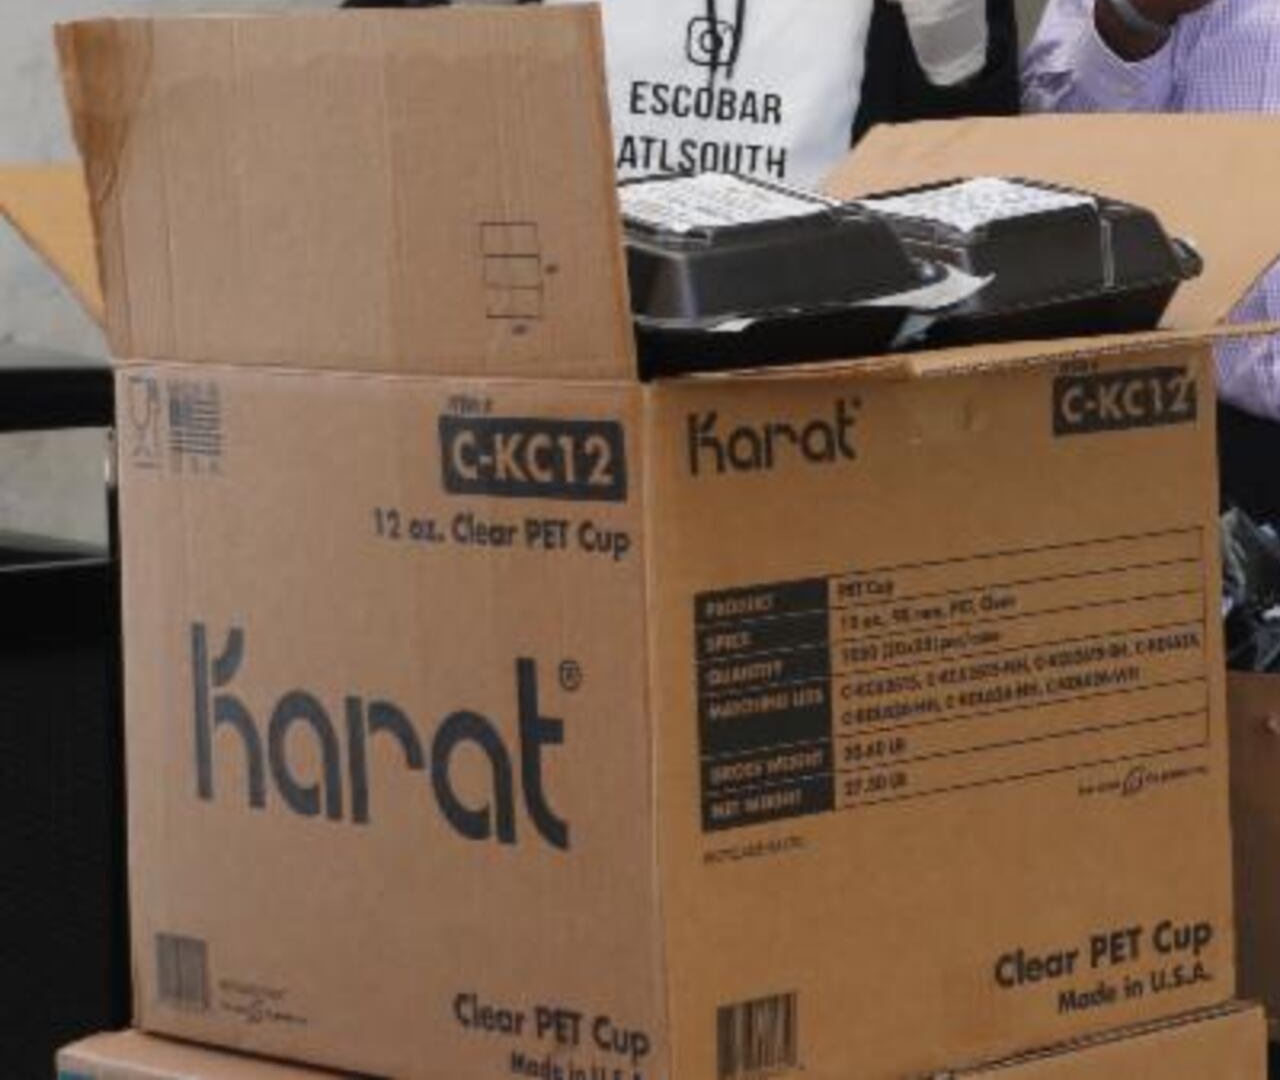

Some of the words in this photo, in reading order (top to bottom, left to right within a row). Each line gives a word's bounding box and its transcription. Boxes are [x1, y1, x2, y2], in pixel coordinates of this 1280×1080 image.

[628, 80, 784, 125] ESCOBAR
[616, 134, 788, 180] ATLSOUTH
[1061, 375, 1191, 425] C-KC12
[451, 430, 615, 487] C-KC12
[373, 507, 402, 537] 12
[408, 520, 445, 544] oz.
[451, 515, 518, 549] Clear
[525, 518, 569, 551] PET
[578, 522, 631, 561] Cup
[994, 948, 1080, 989] Clear
[1090, 927, 1143, 970] PET
[1152, 919, 1213, 957] Cup
[1057, 985, 1118, 1015] Made
[1124, 976, 1144, 998] in
[452, 992, 525, 1037] Clear
[533, 1004, 584, 1047] PET
[591, 1014, 652, 1068] Cup
